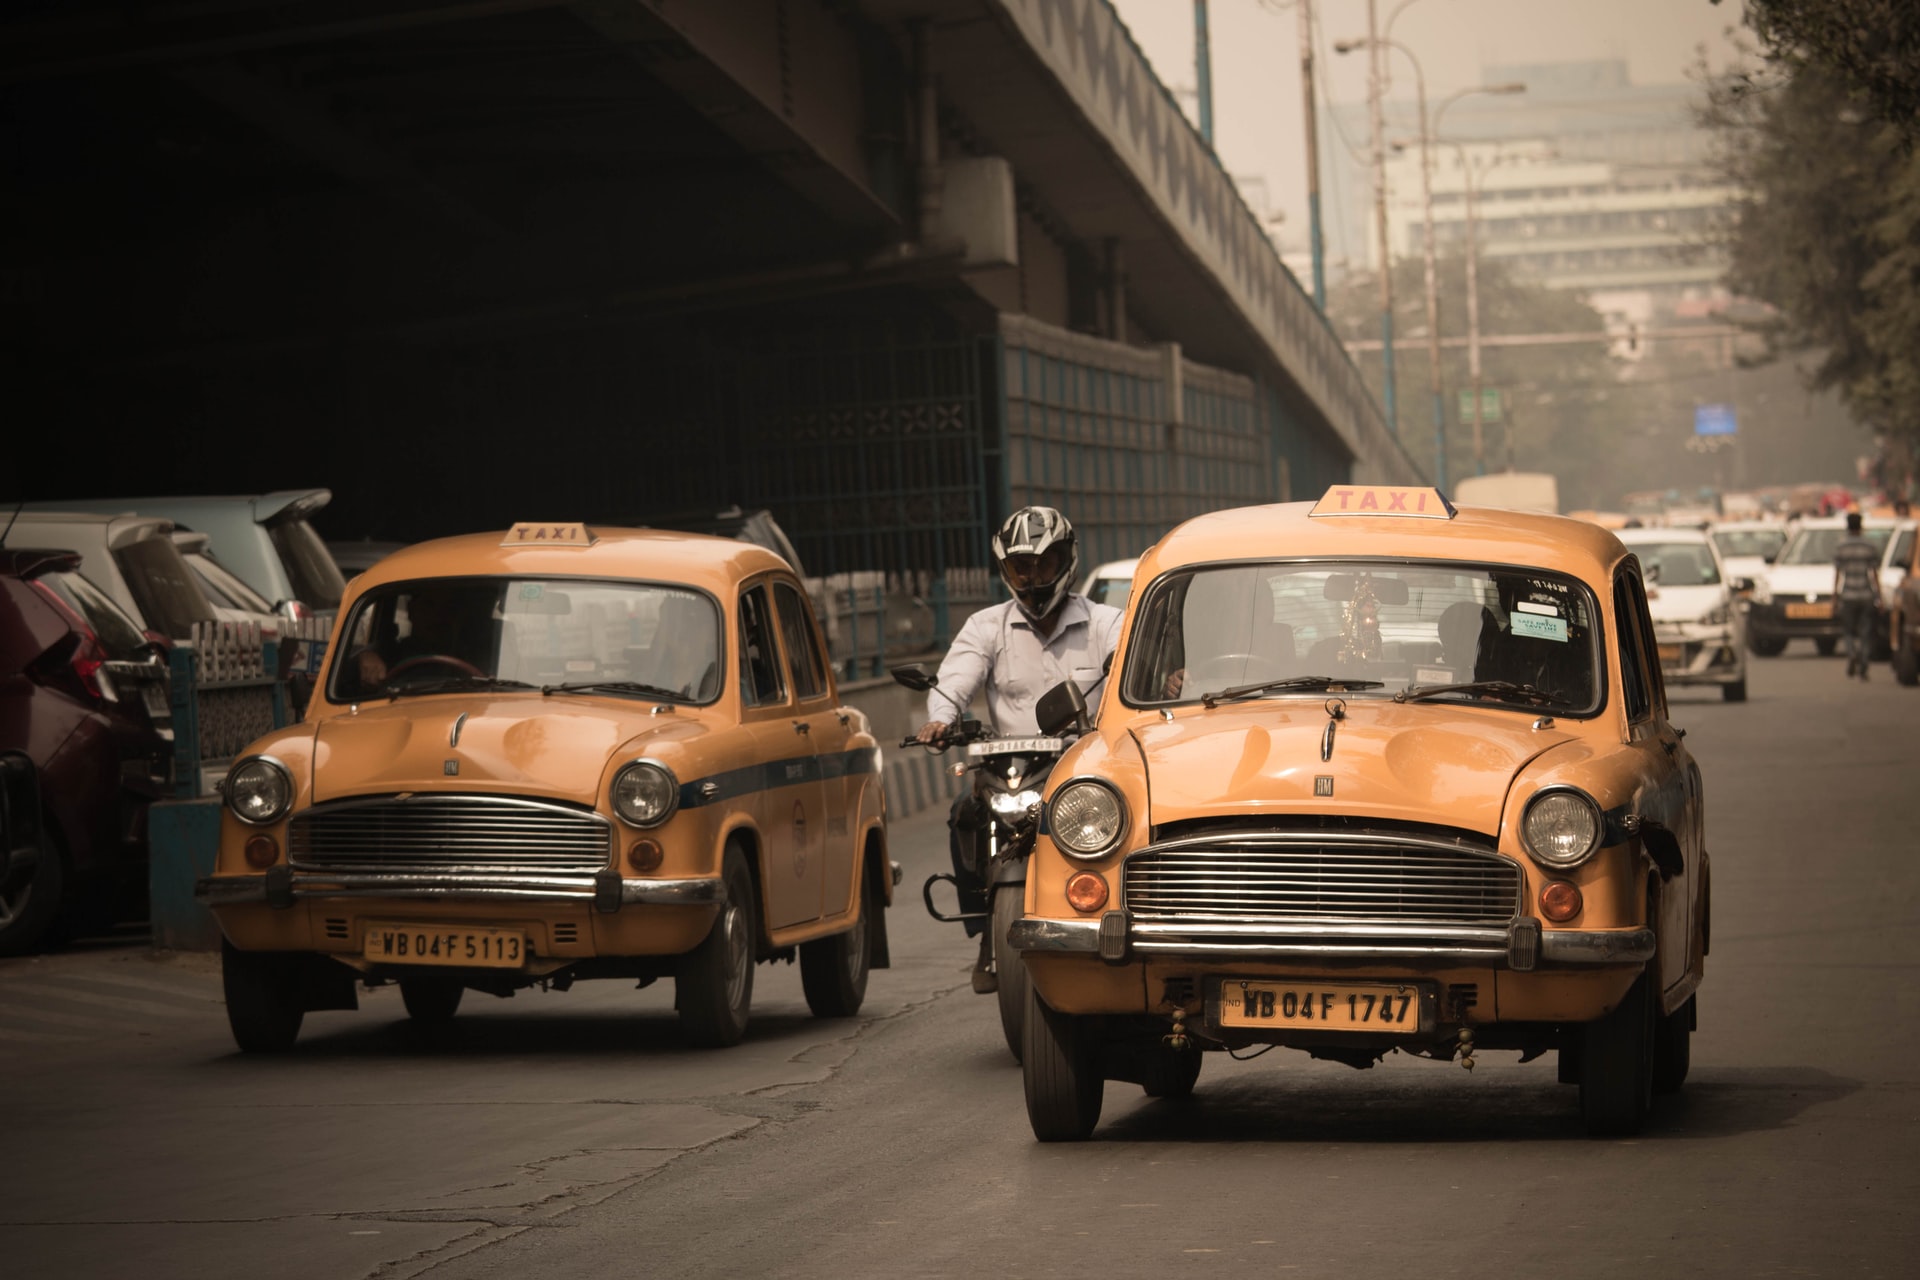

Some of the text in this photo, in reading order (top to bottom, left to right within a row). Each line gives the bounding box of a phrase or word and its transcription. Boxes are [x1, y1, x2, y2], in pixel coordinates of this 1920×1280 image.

[1336, 490, 1426, 512] TAXI
[517, 528, 577, 540] TAXI
[466, 936, 520, 961] 5113
[1225, 999, 1241, 1007] IND
[1347, 993, 1411, 1023] 1747
